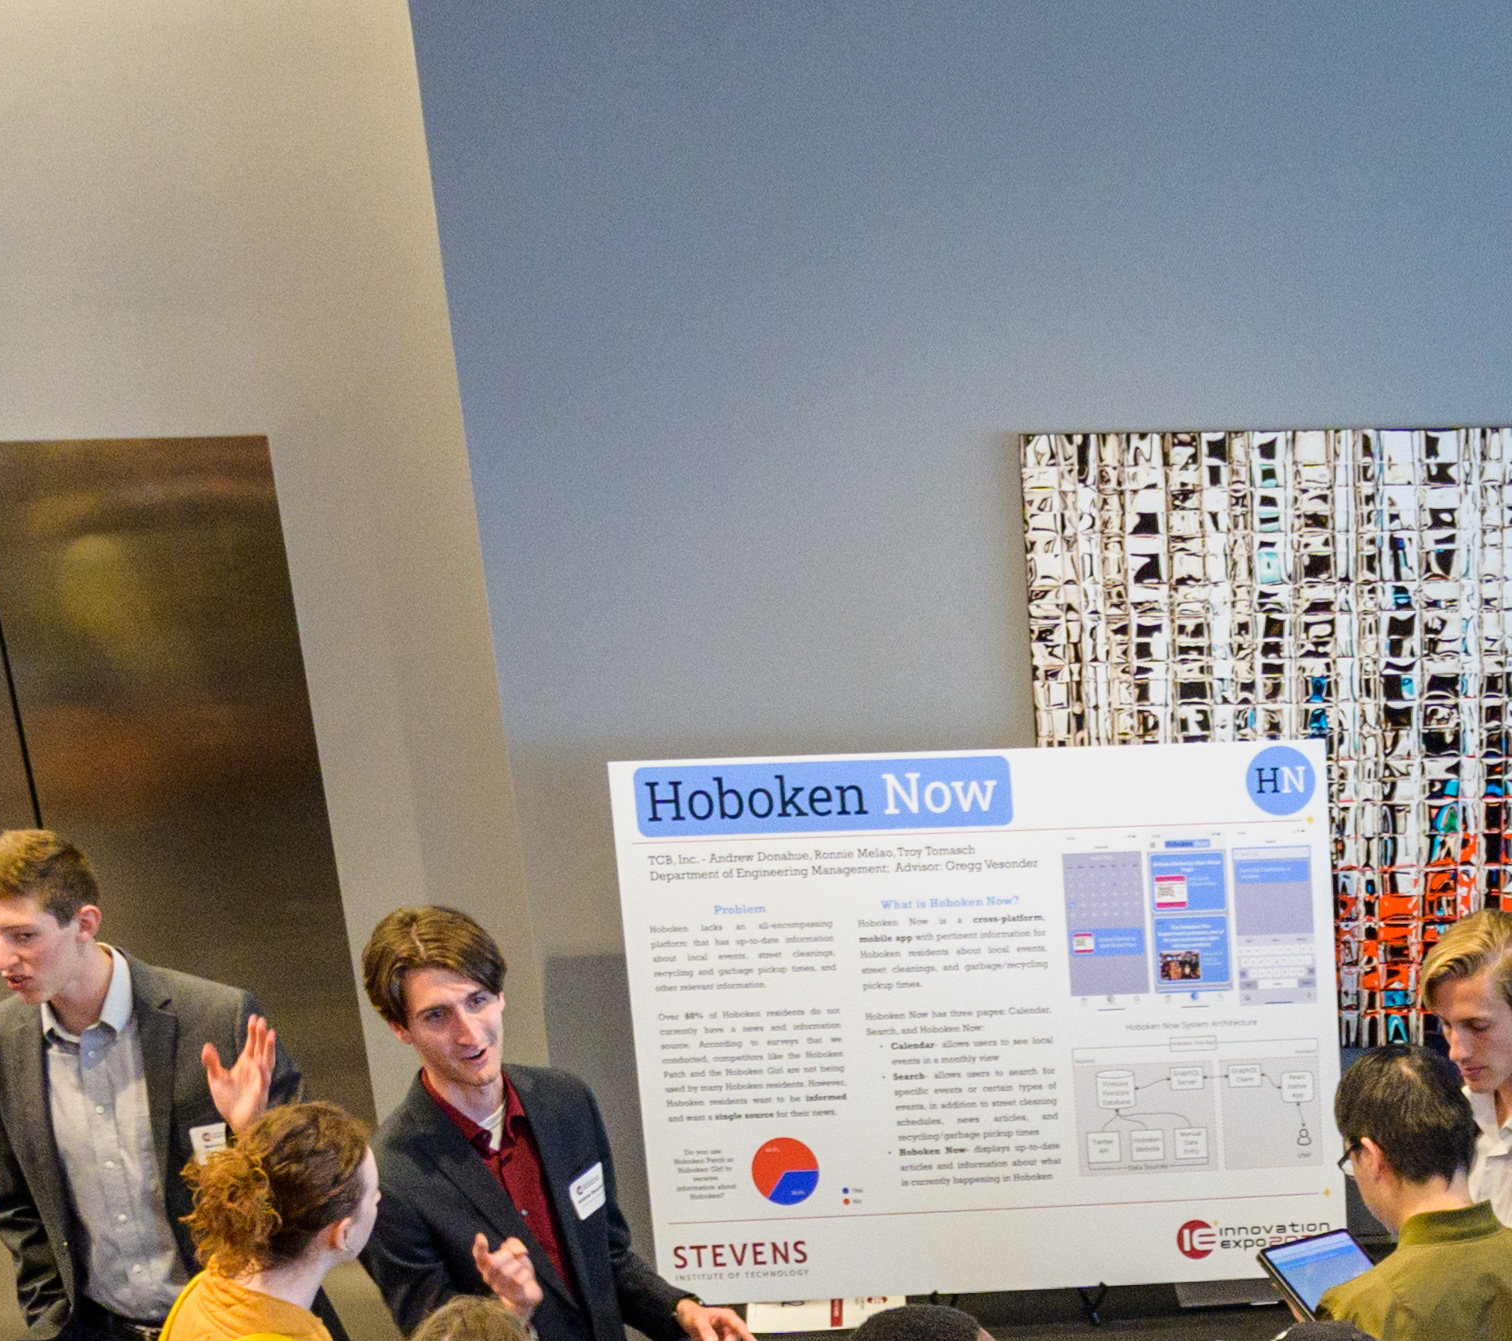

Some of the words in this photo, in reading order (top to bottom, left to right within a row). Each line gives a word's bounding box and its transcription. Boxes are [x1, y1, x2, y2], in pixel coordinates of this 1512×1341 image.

[1255, 767, 1307, 796] HN
[646, 776, 866, 821] Hoboken
[883, 772, 996, 814] Now
[648, 854, 675, 865] TCB,
[678, 854, 698, 864] Inc.
[710, 853, 753, 863] Andrew
[757, 851, 811, 861] Donahue,
[814, 849, 853, 859] Ronnie
[857, 848, 894, 858] Melao,
[897, 846, 922, 858] Troy
[925, 845, 974, 855] Tomasch
[650, 870, 718, 882] Department
[722, 868, 733, 878] of
[736, 867, 807, 879] Engineering
[895, 862, 941, 872] Advisor:
[945, 860, 981, 872] Gregg
[984, 858, 1037, 869] Vesonder
[714, 904, 765, 914] Problem
[881, 900, 911, 909] What
[916, 899, 925, 908] is
[930, 898, 982, 907] Hoboken
[986, 895, 1018, 905] Now?
[1182, 1021, 1208, 1029] System
[1219, 1221, 1330, 1236] innovation
[1178, 1223, 1216, 1255] IE
[674, 1241, 806, 1268] STEVENS
[675, 1272, 722, 1281] INSTITUTE
[745, 1269, 808, 1278] TECHNOLOGY
